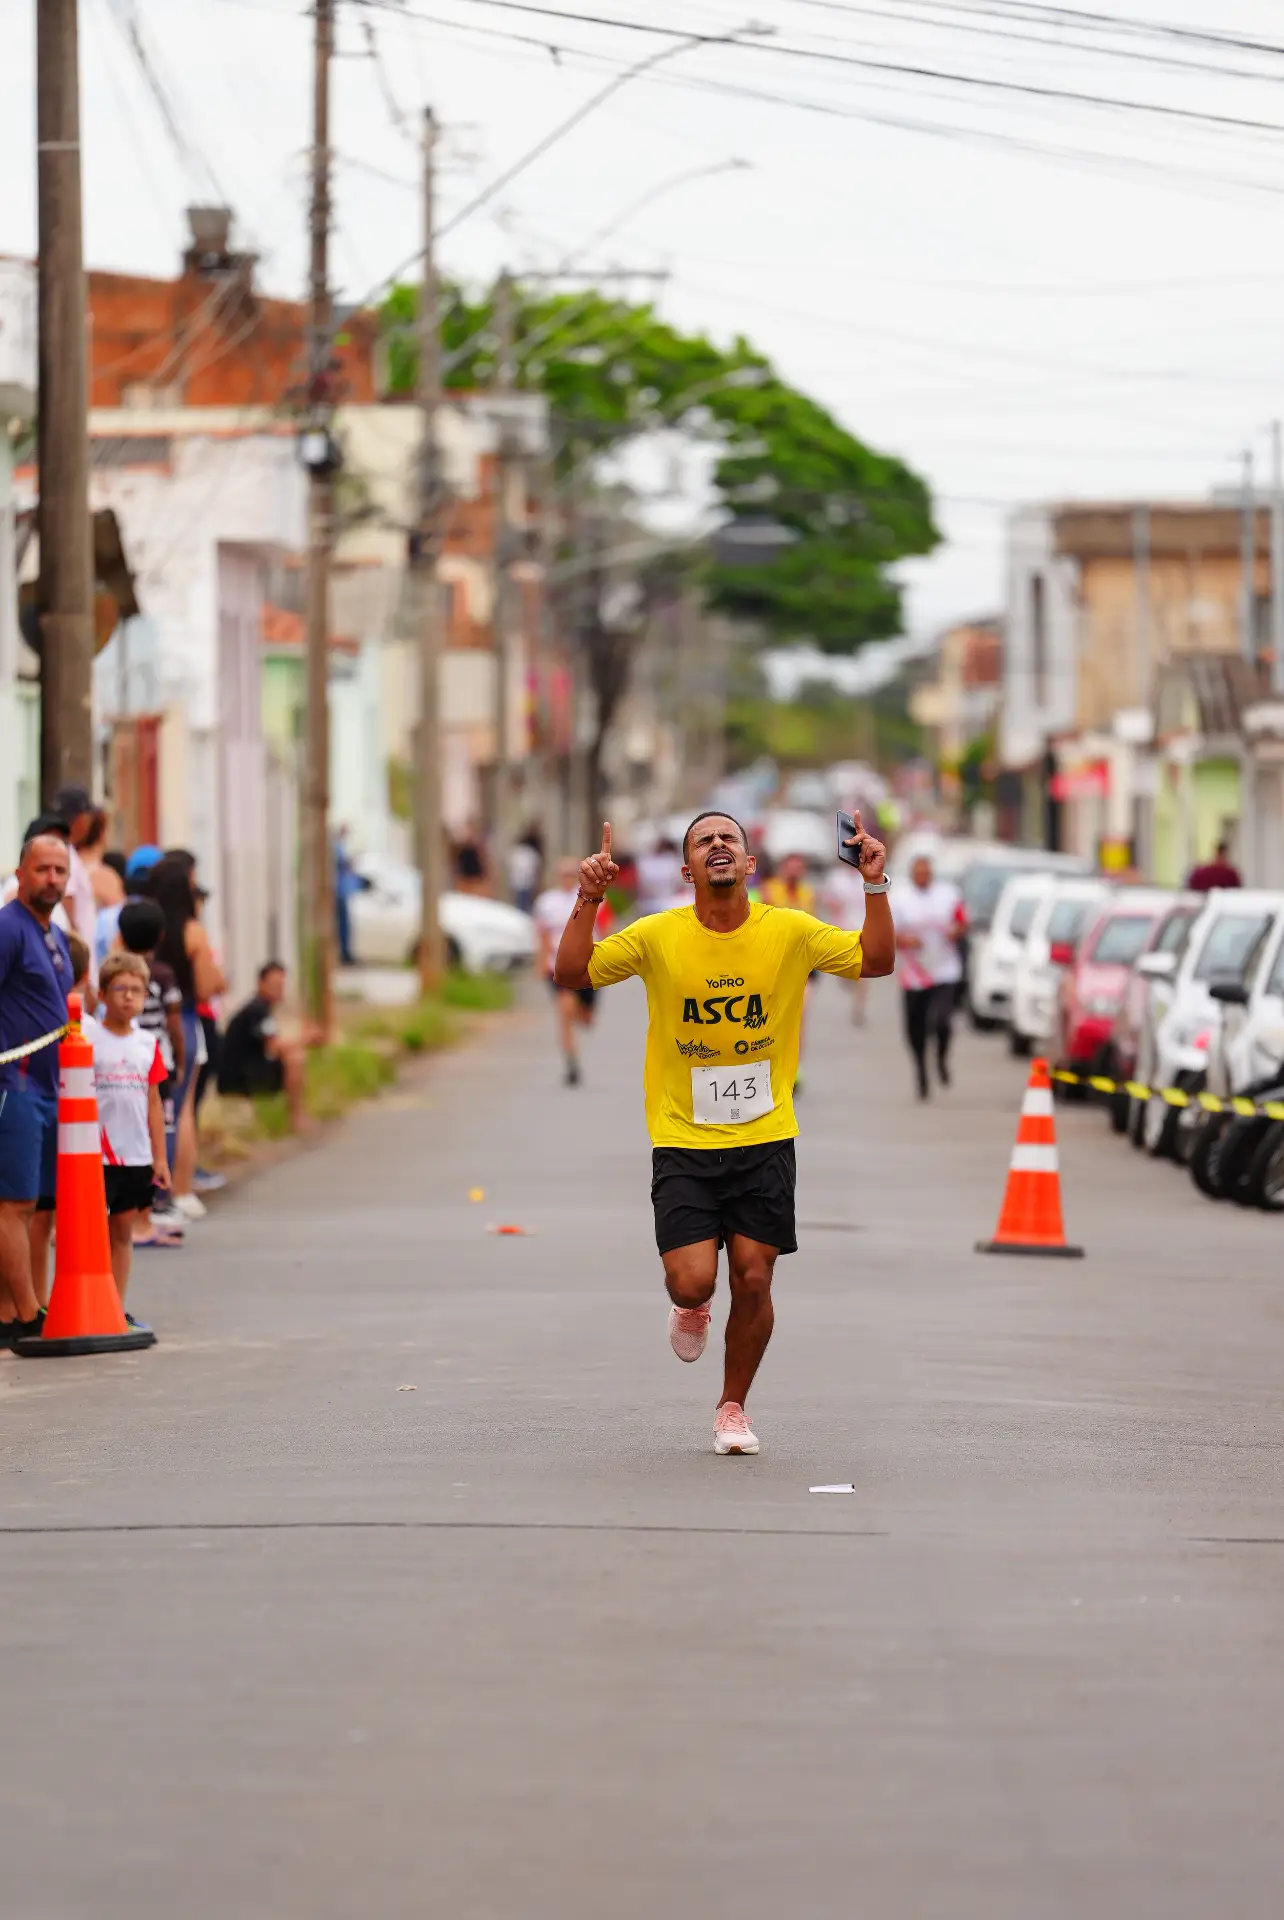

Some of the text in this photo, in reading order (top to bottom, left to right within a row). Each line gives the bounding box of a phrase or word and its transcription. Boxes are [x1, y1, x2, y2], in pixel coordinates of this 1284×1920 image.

[706, 977, 744, 988] YoPRO
[683, 994, 762, 1024] ASCA
[742, 1012, 768, 1030] RUN
[709, 1076, 757, 1102] 143
